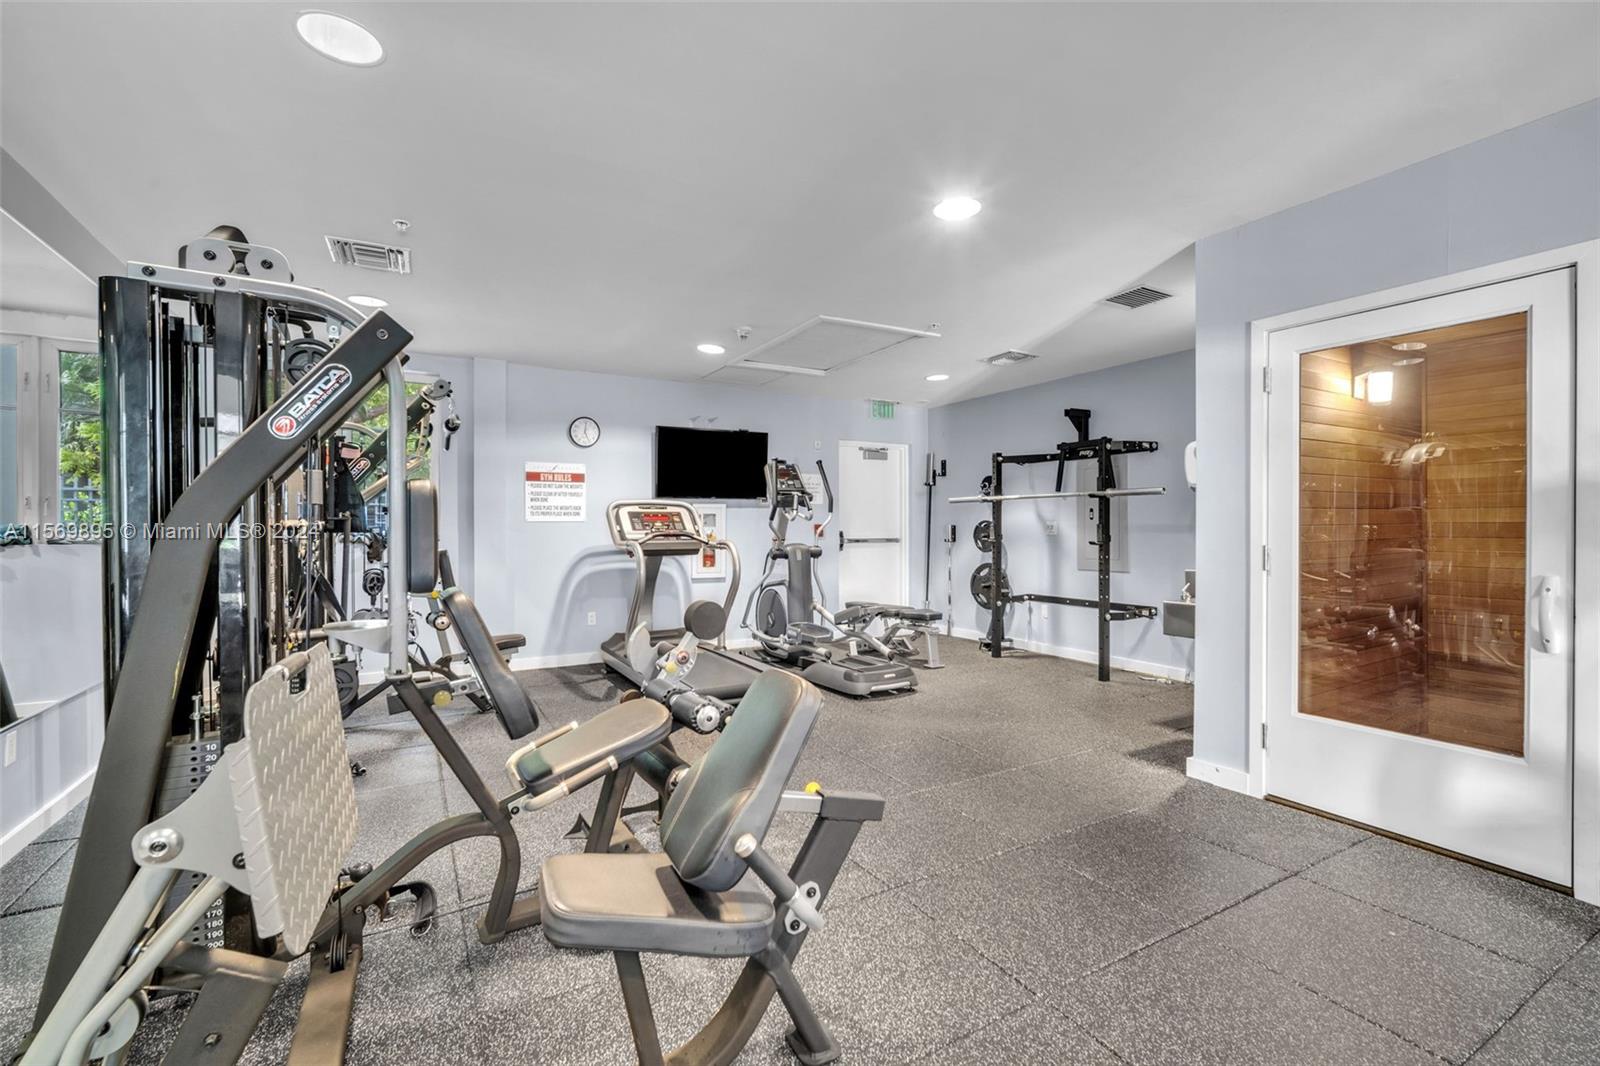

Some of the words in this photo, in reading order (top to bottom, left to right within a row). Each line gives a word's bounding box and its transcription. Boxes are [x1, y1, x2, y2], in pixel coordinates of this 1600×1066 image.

[287, 369, 348, 418] BATCA
[540, 473, 553, 481] GYM
[554, 473, 572, 482] RULES
[205, 743, 217, 751] 10
[205, 754, 217, 762] 20
[206, 909, 223, 918] 170
[207, 919, 224, 929] 180
[207, 930, 224, 939] 190
[207, 940, 225, 949] 200
